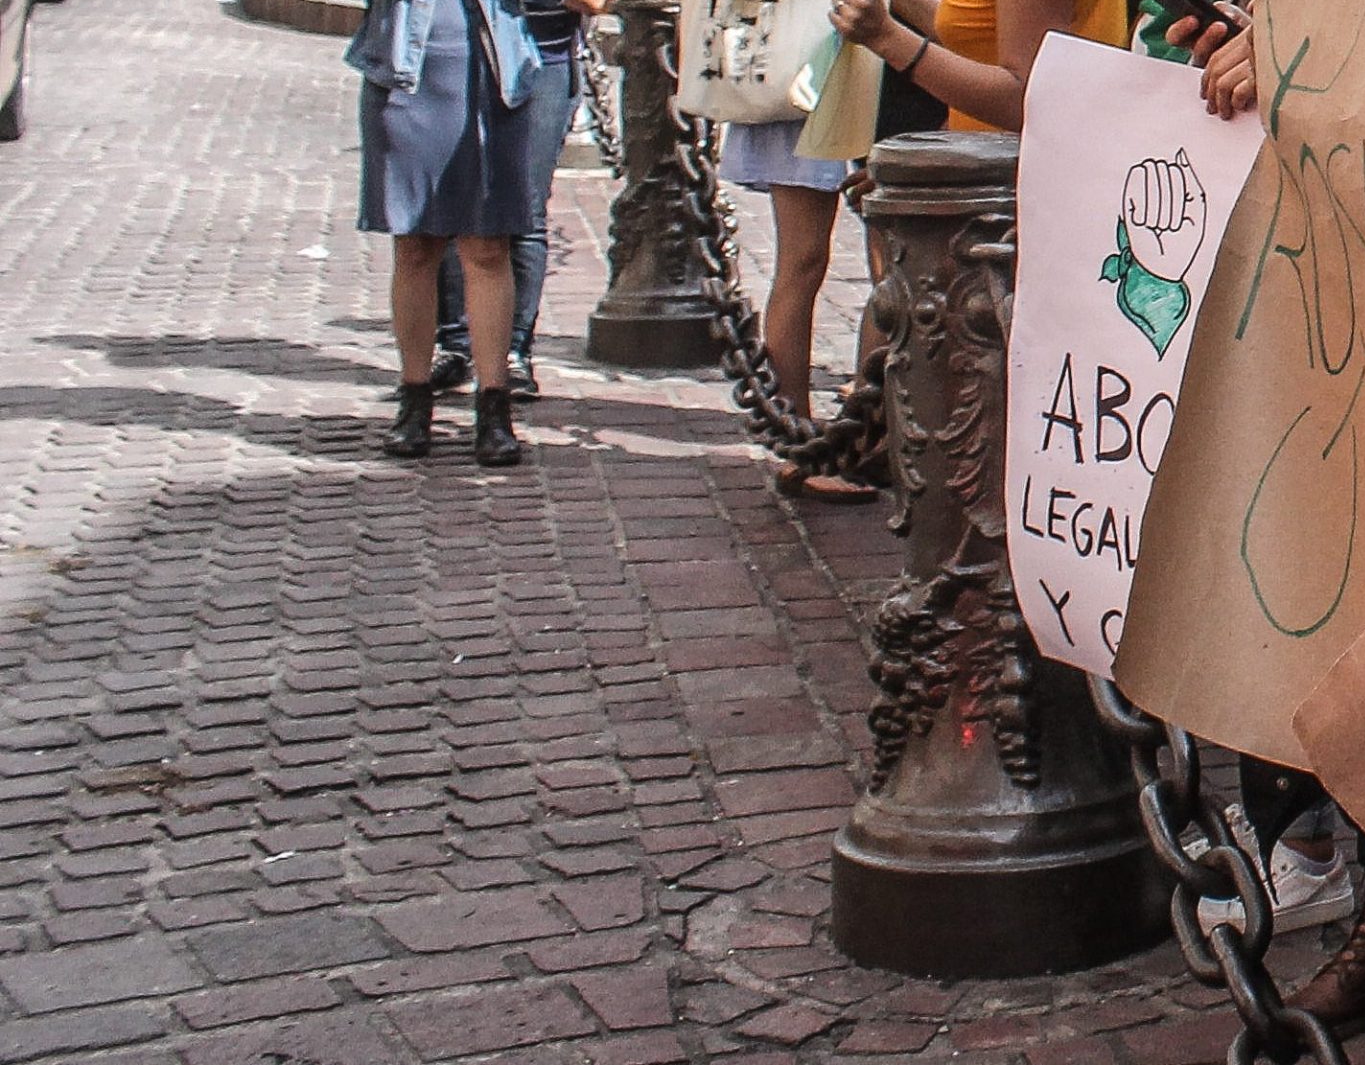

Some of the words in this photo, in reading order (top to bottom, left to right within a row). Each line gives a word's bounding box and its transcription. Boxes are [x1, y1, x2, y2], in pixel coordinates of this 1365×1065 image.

[1041, 352, 1176, 476] ABO
[1022, 474, 1137, 572] LEGAL
[1038, 578, 1075, 648] Y
